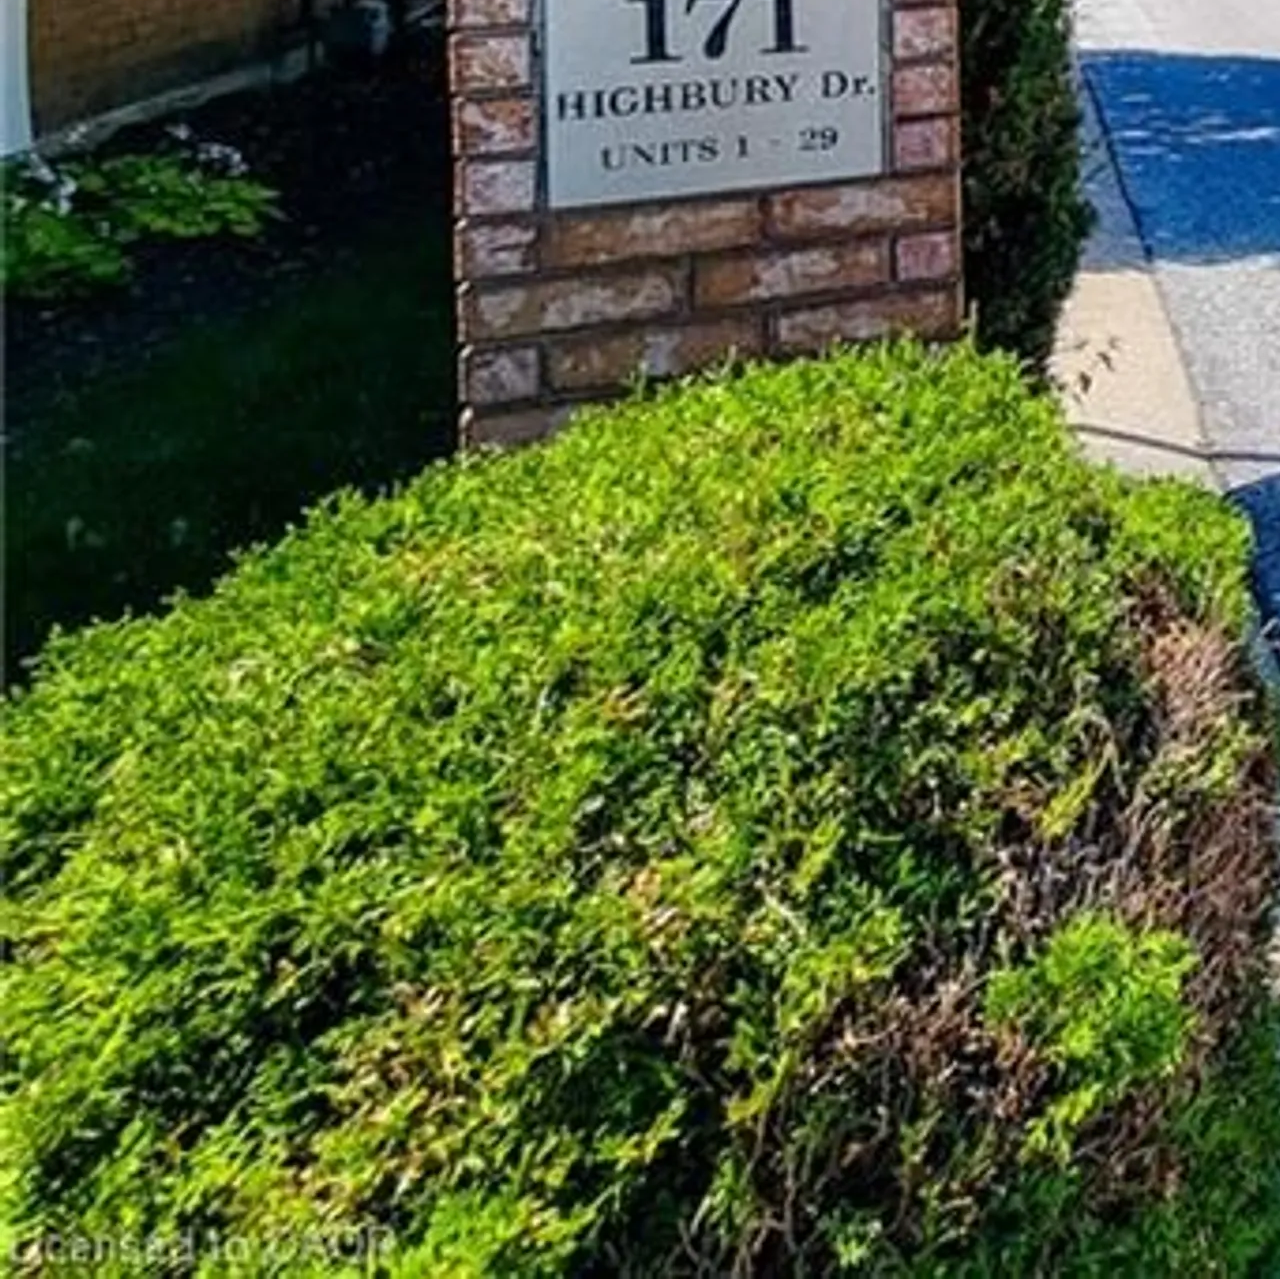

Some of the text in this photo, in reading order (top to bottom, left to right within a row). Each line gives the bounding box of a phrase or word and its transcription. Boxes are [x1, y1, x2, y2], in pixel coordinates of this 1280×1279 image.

[556, 70, 877, 121] HIGHBURY Dr.
[602, 136, 720, 171] UNITS
[737, 136, 749, 159] 1
[798, 126, 839, 152] 29
